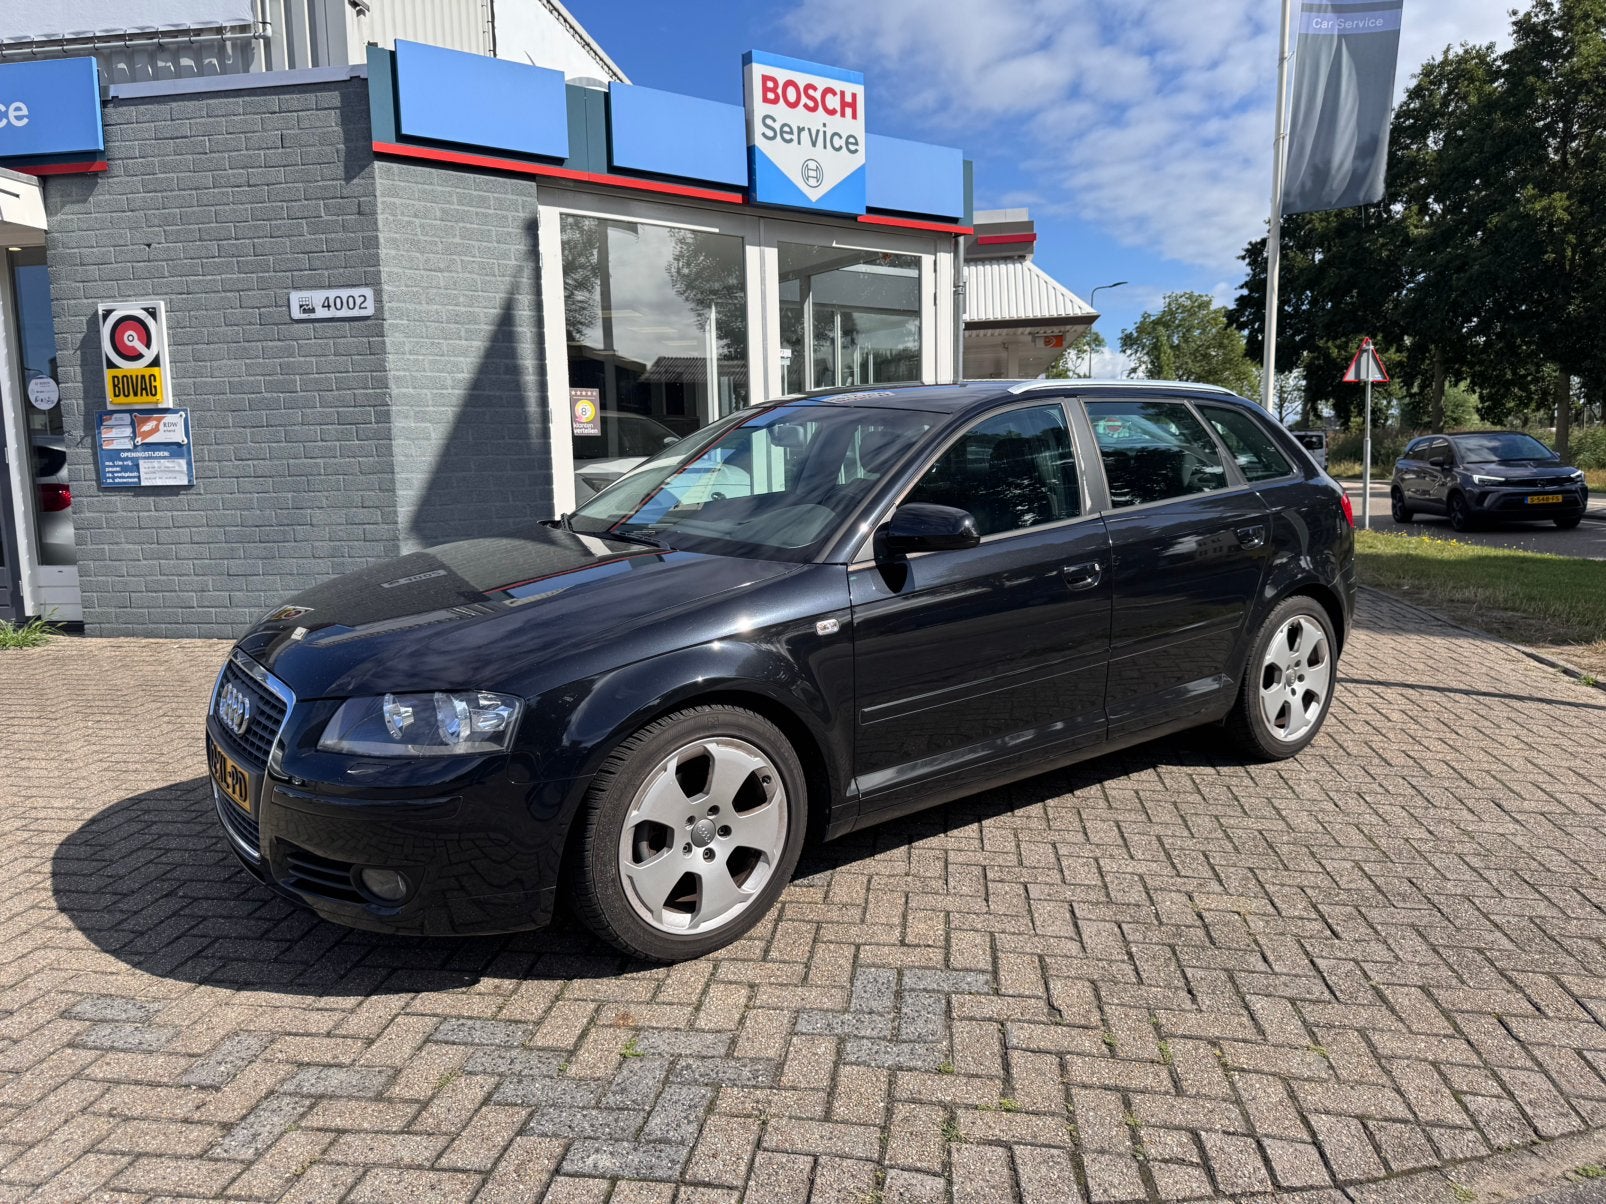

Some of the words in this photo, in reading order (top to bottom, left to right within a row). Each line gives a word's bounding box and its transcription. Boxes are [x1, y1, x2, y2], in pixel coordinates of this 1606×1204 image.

[1312, 18, 1334, 29] Car
[1337, 17, 1384, 29] Service
[761, 74, 858, 121] BOSCH
[761, 114, 859, 155] Service
[321, 294, 368, 311] 4002
[112, 373, 158, 398] BOVAG
